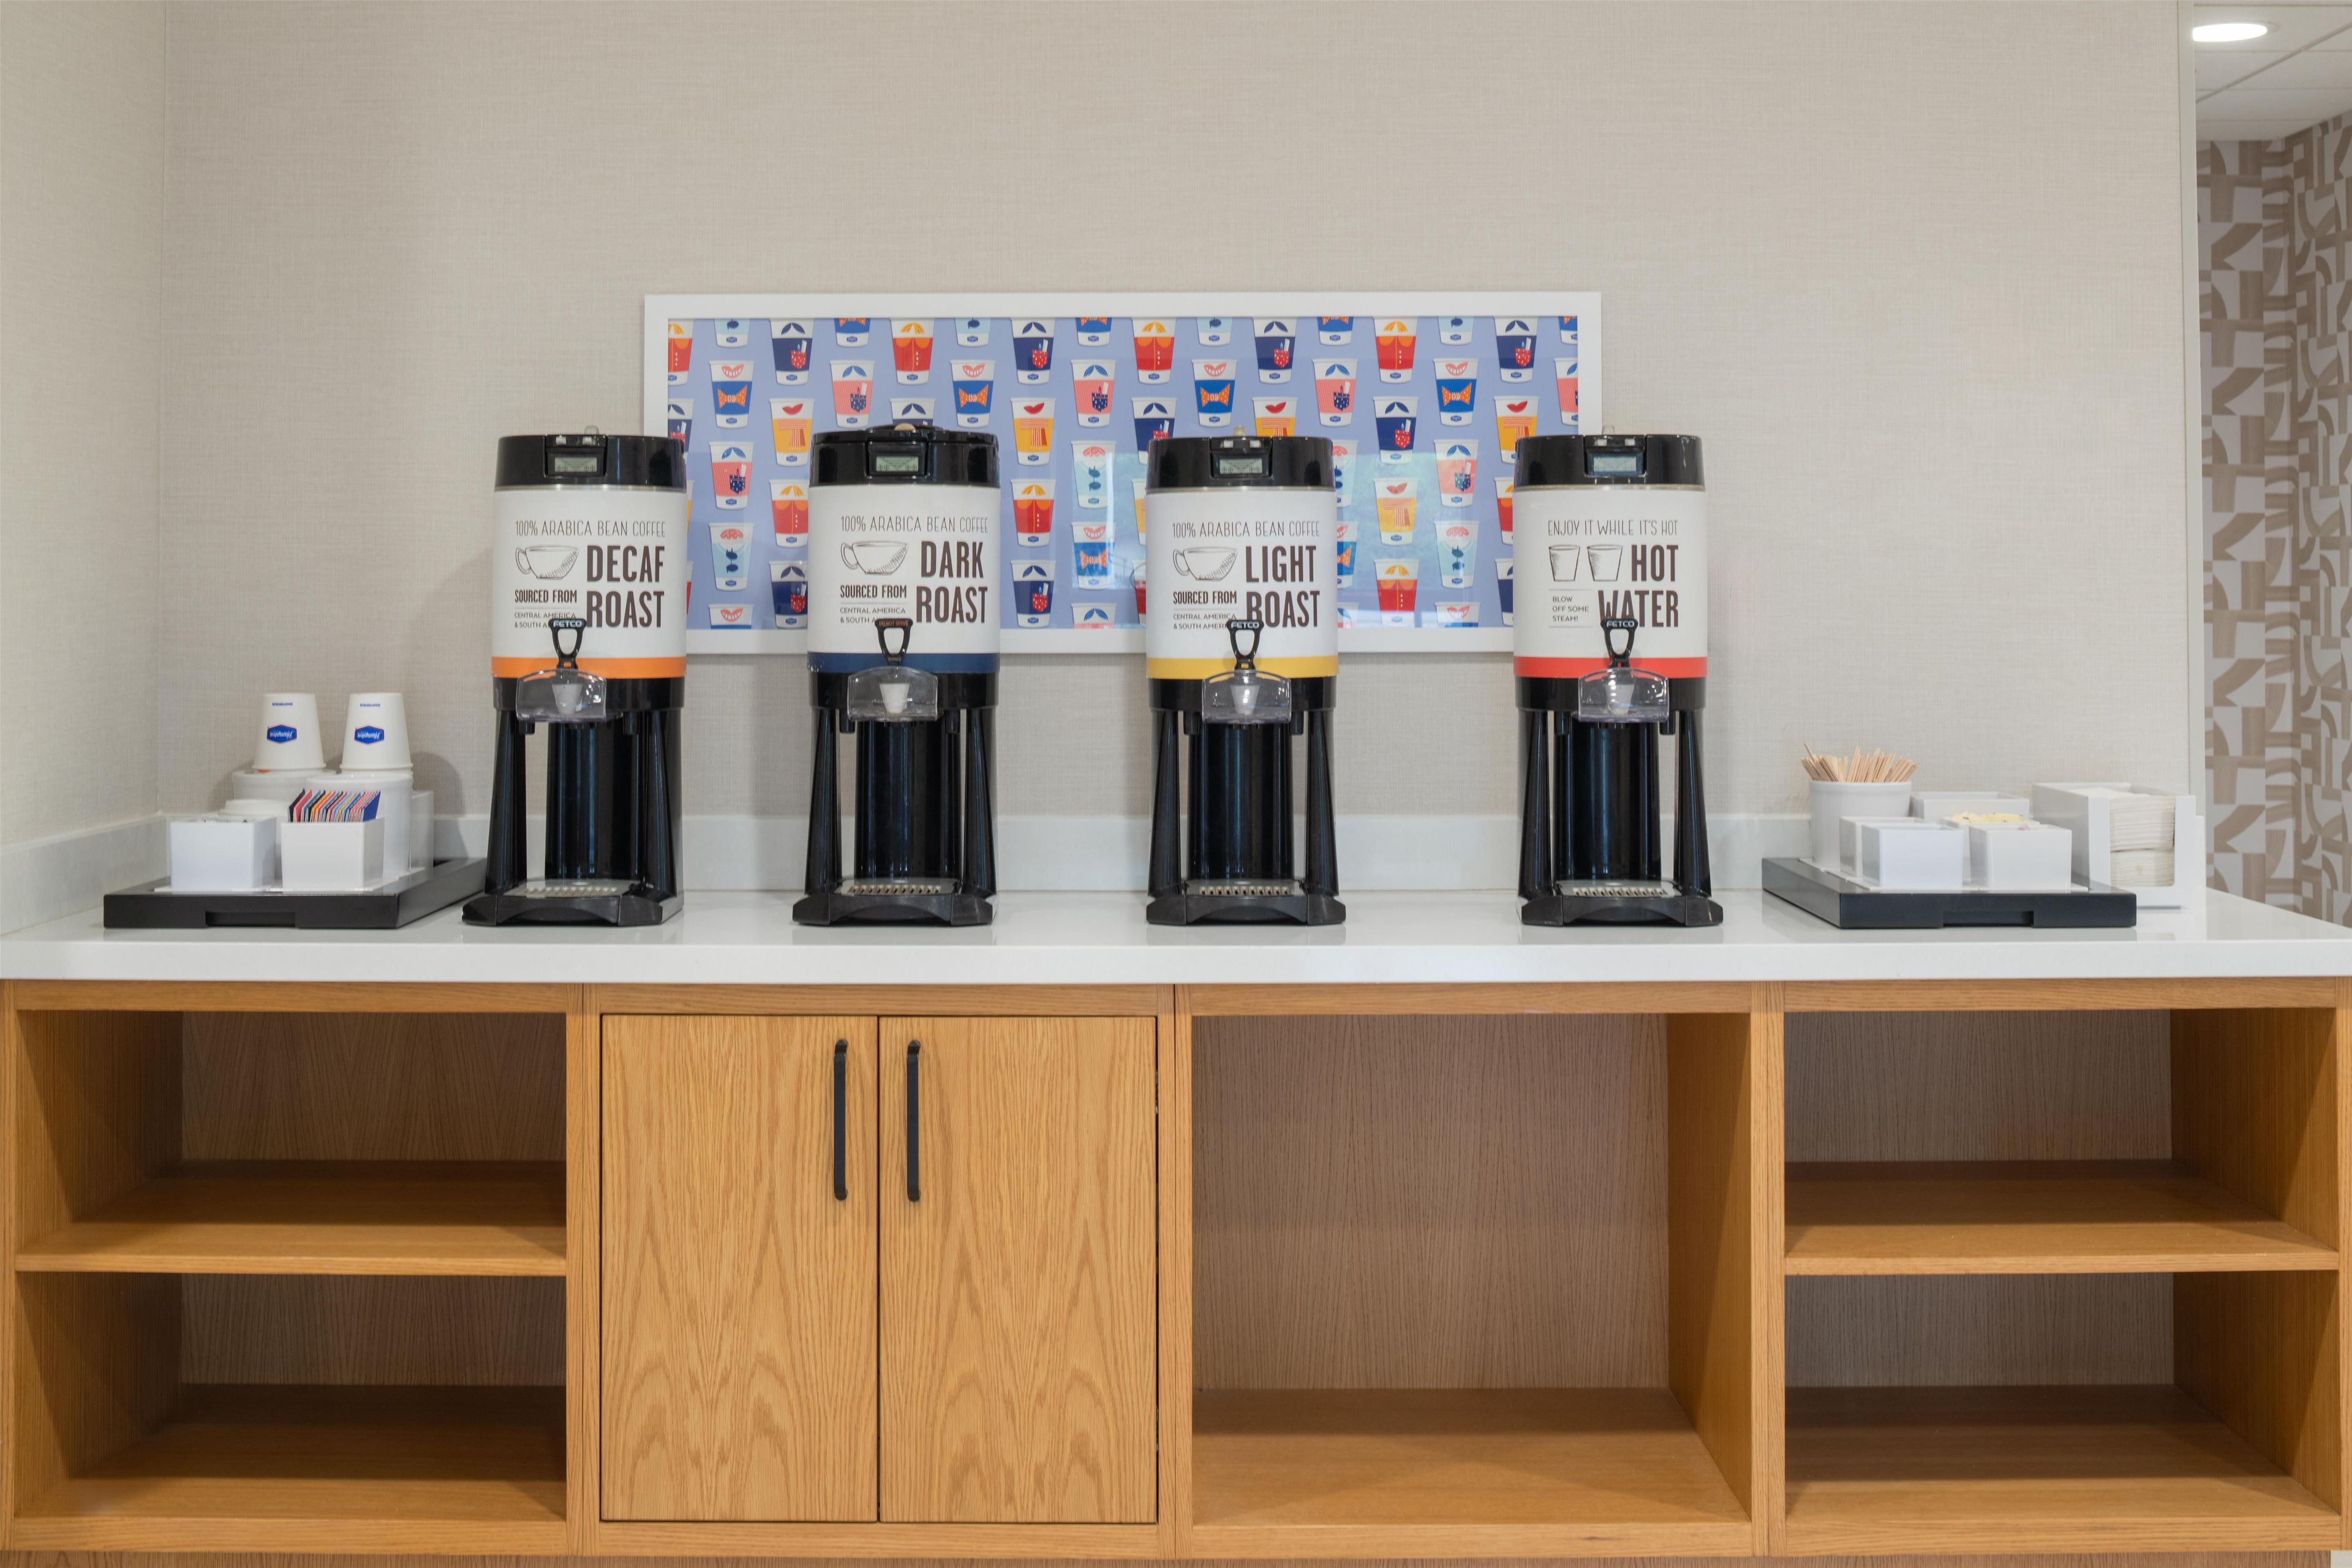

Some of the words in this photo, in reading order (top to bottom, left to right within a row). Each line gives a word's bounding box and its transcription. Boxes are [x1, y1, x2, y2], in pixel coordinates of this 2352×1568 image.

[515, 521, 538, 537] 100%
[541, 520, 592, 536] ARABICA
[598, 521, 627, 537] BEAN
[633, 521, 666, 537] COFFEE
[841, 516, 865, 532] 100%
[870, 516, 921, 532] ARABICA
[927, 516, 955, 532] BEAN
[960, 517, 988, 533] COFFEE
[1172, 522, 1196, 538] 100%
[1200, 521, 1250, 537] ARABICA
[1256, 521, 1284, 537] BEAN
[1289, 521, 1319, 537] COFFEE
[1548, 520, 1580, 536] ENJOY
[1585, 520, 1593, 535] IT
[1597, 519, 1634, 536] WHILE
[1640, 519, 1657, 536] IT'S
[1661, 519, 1678, 536] HOT
[587, 545, 665, 582] DECAF
[921, 541, 984, 578] DARK
[1246, 546, 1316, 582] LIGHT
[1631, 544, 1678, 582] HOT
[514, 589, 548, 603] SOURCED
[552, 589, 577, 603] FROM
[840, 585, 878, 598] SOURCED
[882, 585, 907, 598] FROM
[1173, 591, 1208, 605] SOURCED
[1212, 590, 1237, 603] FROM
[586, 590, 665, 628] ROAST
[916, 586, 987, 623] ROAST
[1246, 590, 1320, 628] ROAST
[1597, 590, 1679, 627] WATER
[270, 730, 293, 739] Hampton
[357, 731, 381, 740] Hampton
